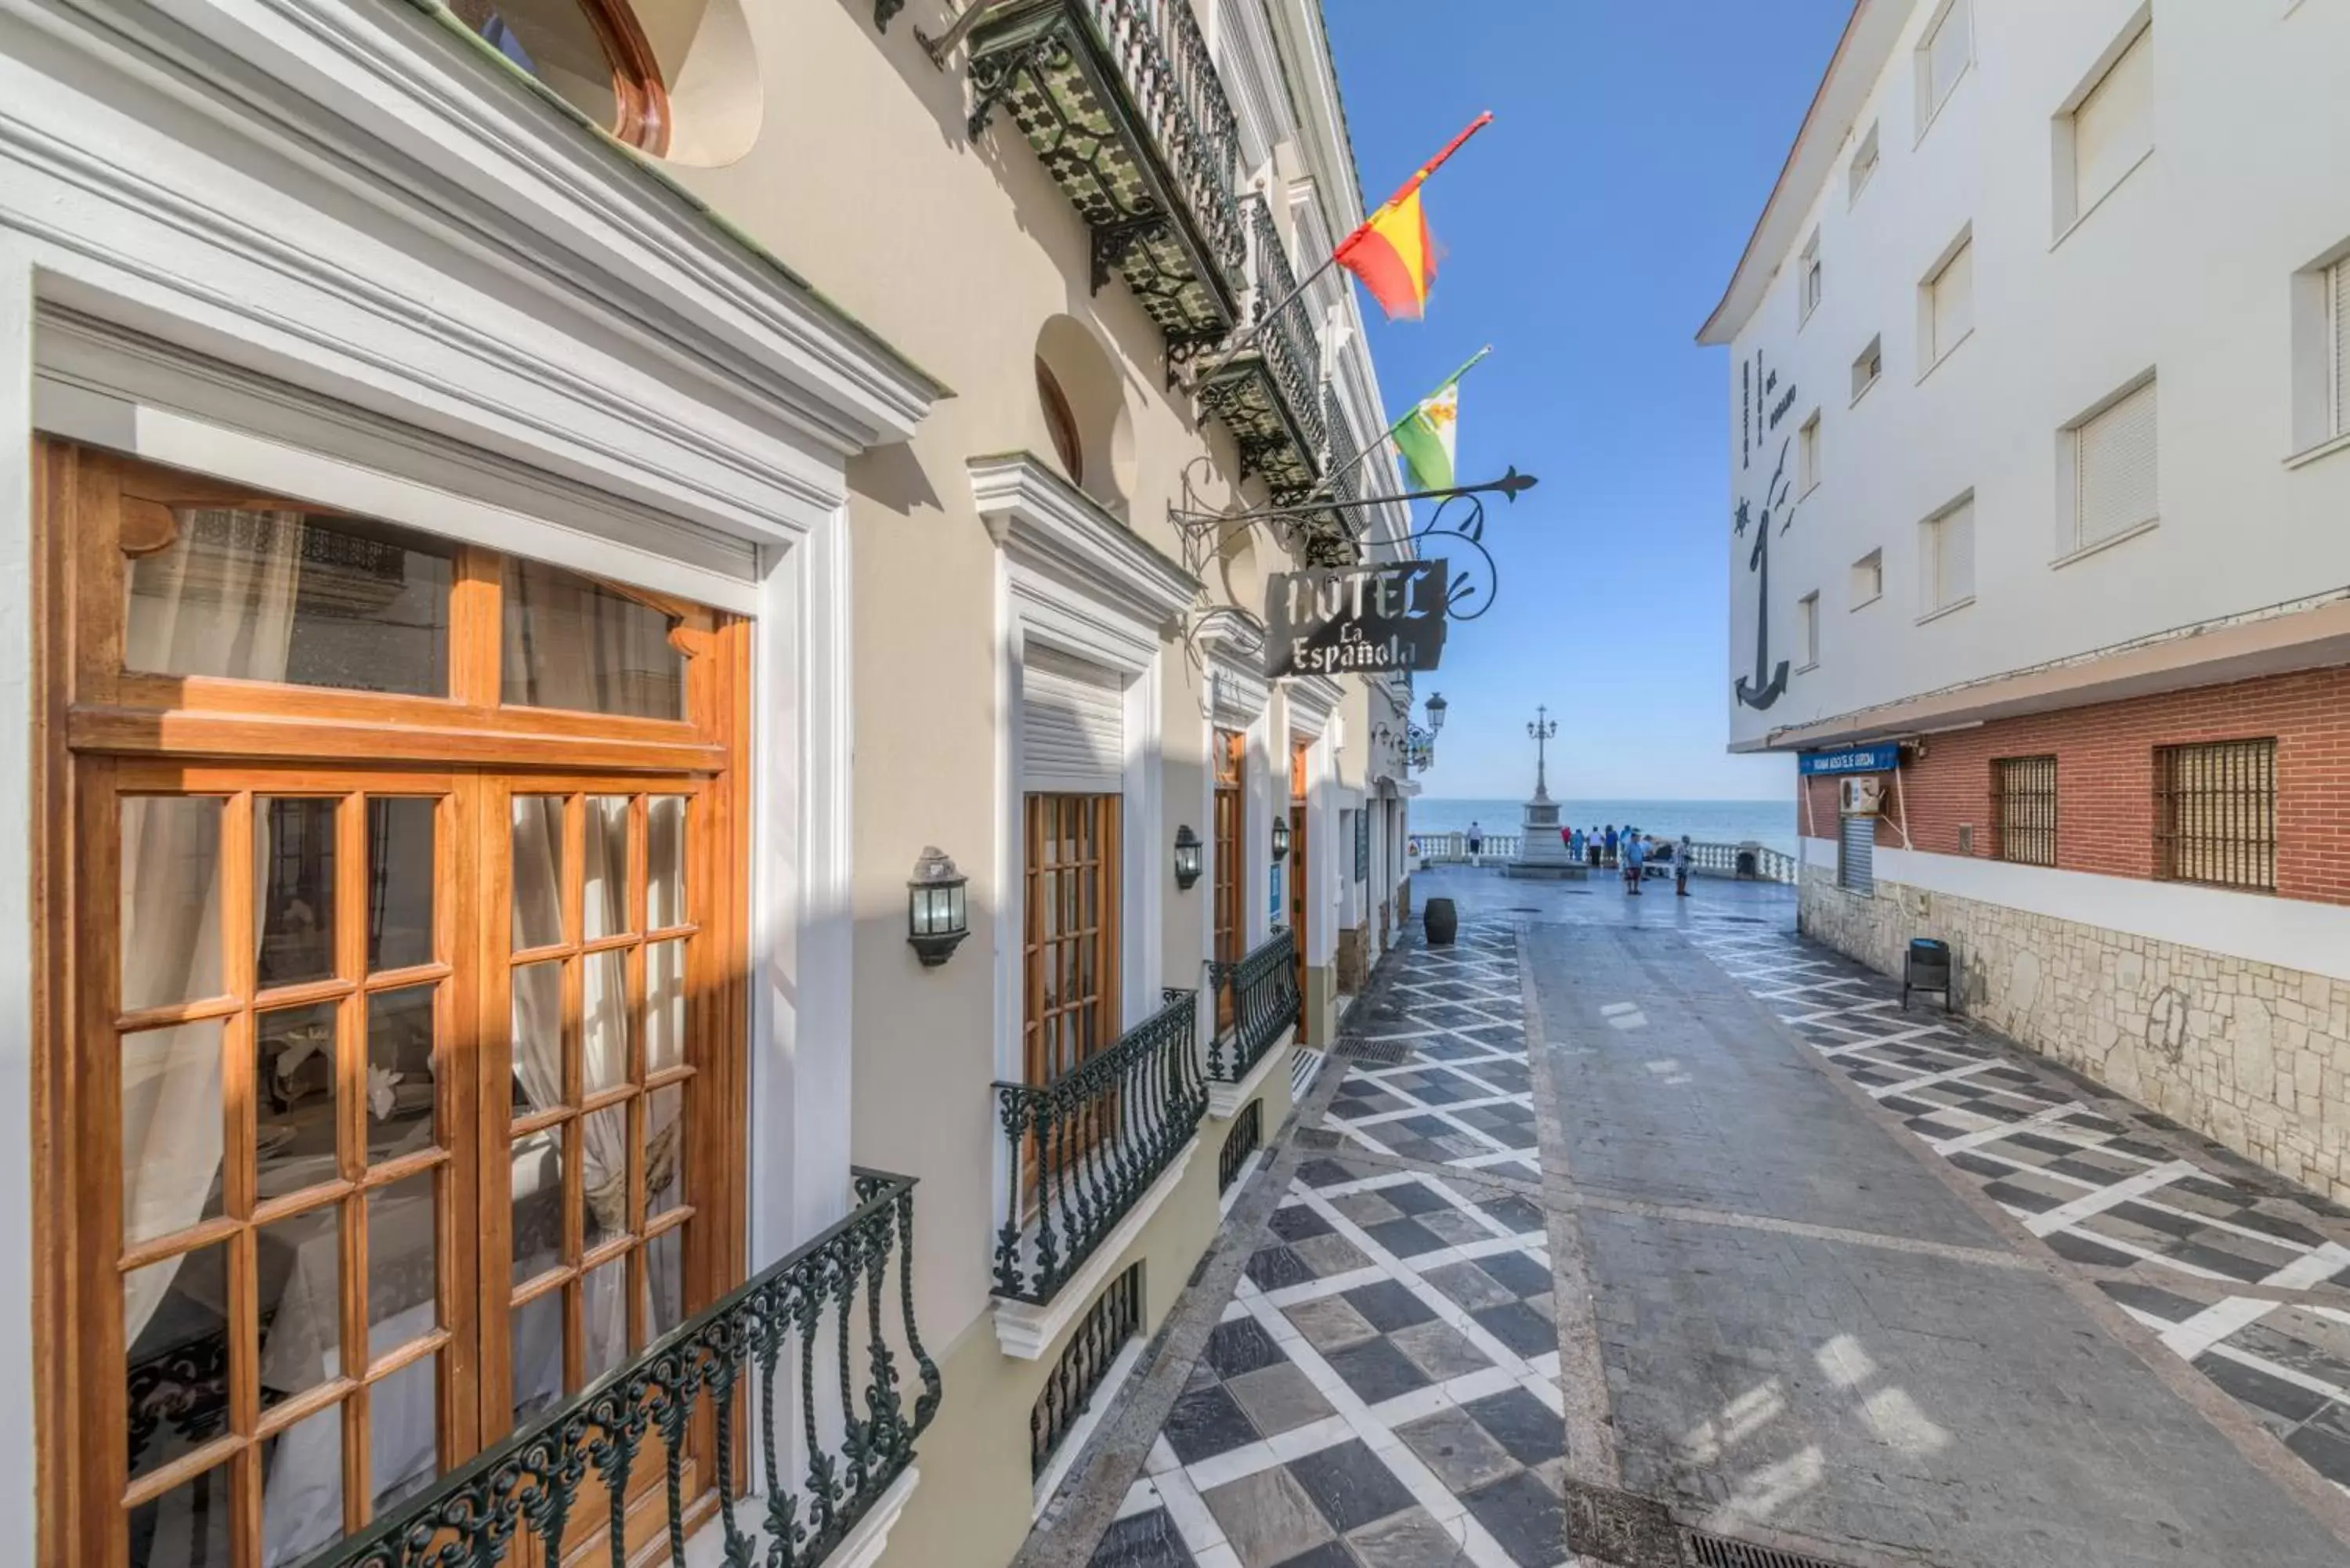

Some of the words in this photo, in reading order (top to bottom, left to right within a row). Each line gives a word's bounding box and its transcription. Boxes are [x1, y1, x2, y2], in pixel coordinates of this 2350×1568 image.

[1286, 569, 1431, 624] HOTEL
[1340, 622, 1363, 643] La
[1291, 634, 1416, 673] Española
